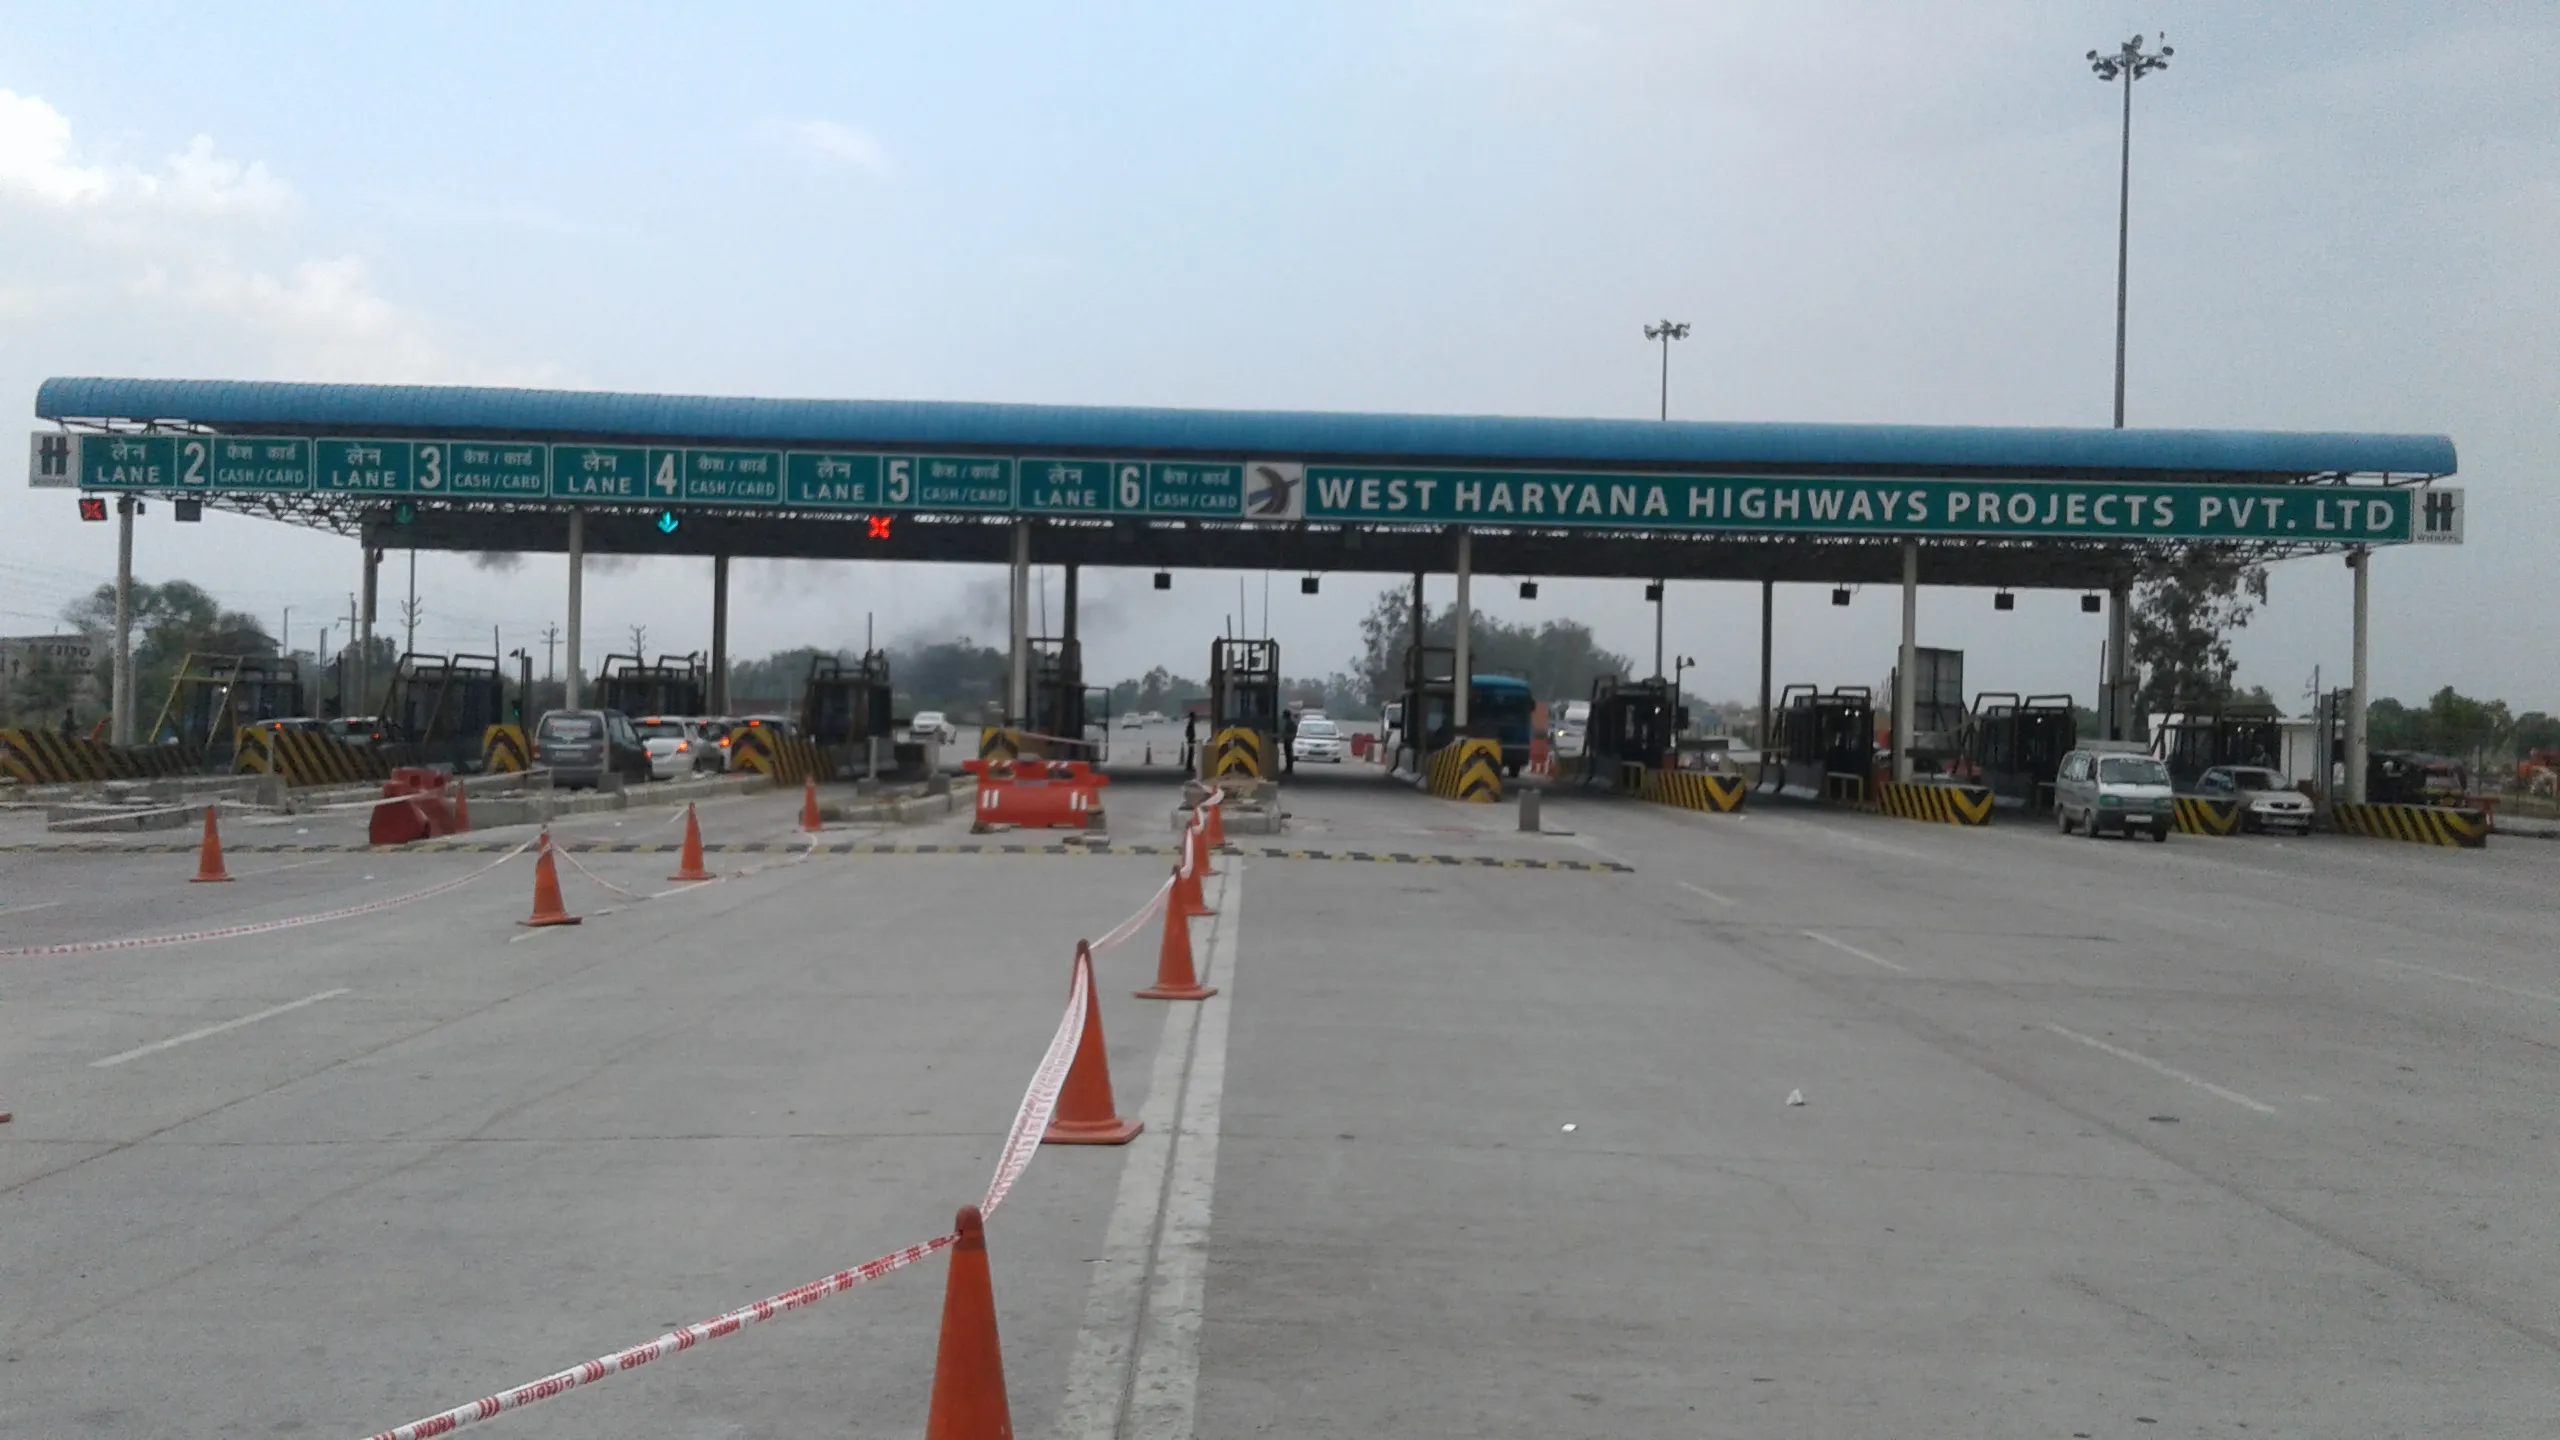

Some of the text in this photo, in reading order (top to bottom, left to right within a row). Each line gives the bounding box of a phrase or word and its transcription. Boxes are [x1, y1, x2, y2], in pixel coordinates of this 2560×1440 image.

[110, 438, 147, 461] लेन
[346, 443, 381, 466] लेन
[582, 449, 618, 472] लेन
[97, 465, 160, 483] LANE
[183, 441, 206, 484] 2
[419, 446, 441, 489] 3
[655, 453, 677, 495] 4
[816, 455, 851, 479] लेन
[1048, 461, 1082, 485] लेन
[219, 467, 304, 483] CASH/CARD
[332, 471, 396, 488] LANE
[454, 473, 540, 489] CASH/CARD
[568, 476, 632, 494] LANE
[889, 460, 911, 502] 5
[690, 480, 776, 496] CASH/CARD
[802, 483, 865, 500] LANE
[922, 487, 1008, 502] CASH/CARD
[1033, 489, 1097, 507] LANE
[1119, 466, 1141, 508] 6
[1153, 492, 1238, 509] CASH/CARD
[1317, 477, 2395, 532] WEST HARYANA HIGHWAYS PROJECTS PVT. LTD
